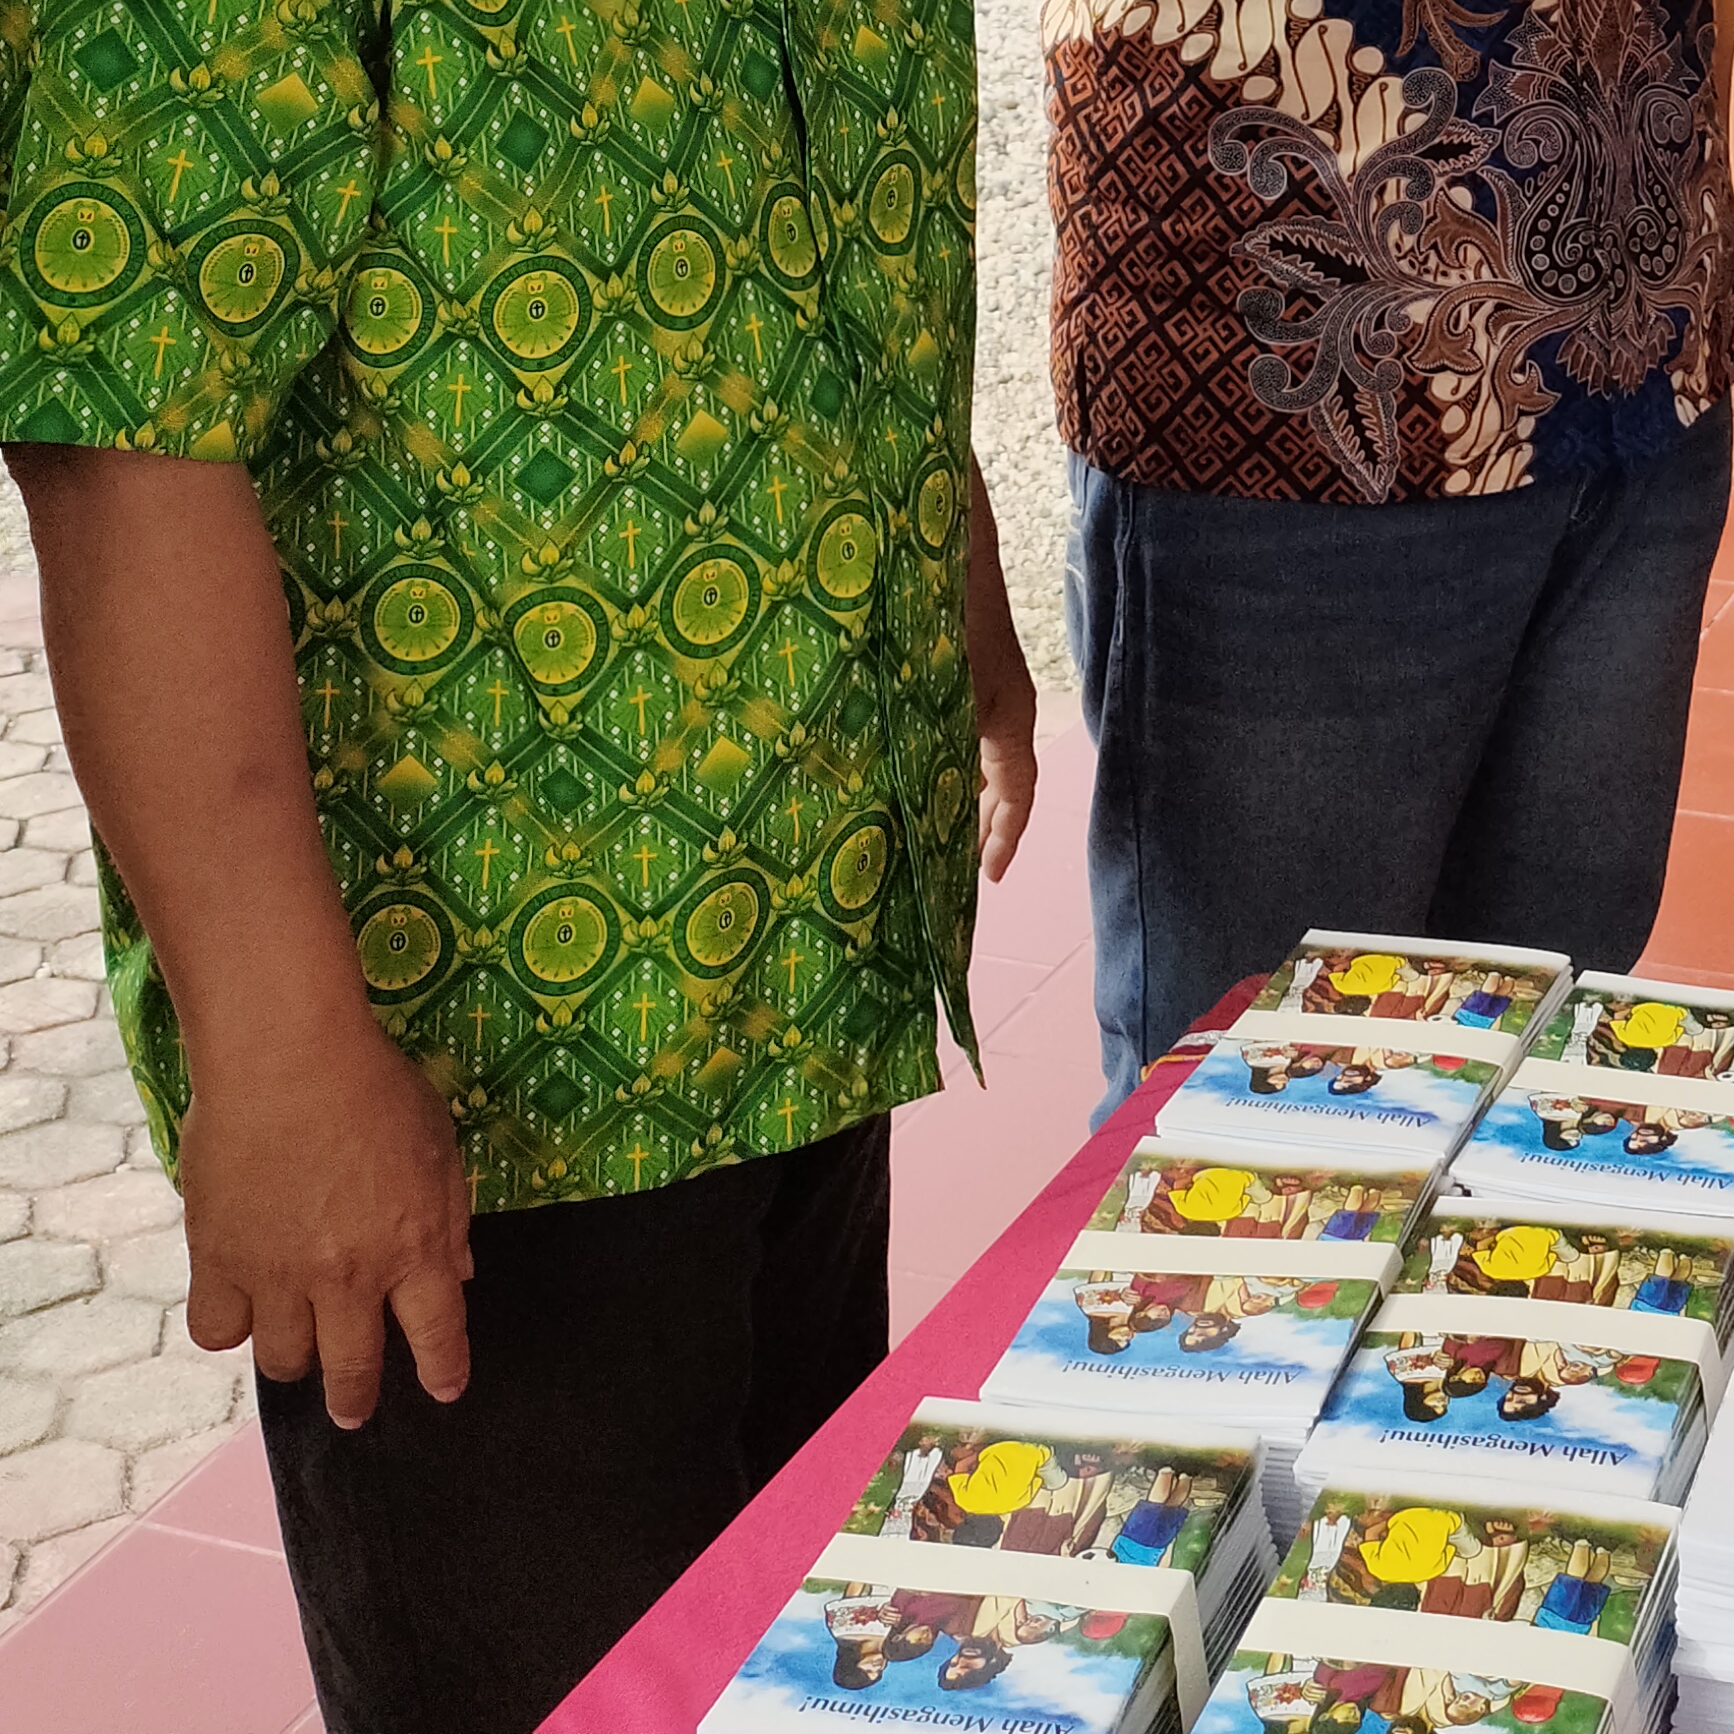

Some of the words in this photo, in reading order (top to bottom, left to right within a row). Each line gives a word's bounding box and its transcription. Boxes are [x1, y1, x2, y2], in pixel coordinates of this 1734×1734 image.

[1225, 1097, 1371, 1121] Mengasihimu!
[1377, 1112, 1432, 1129] Allah
[1520, 1152, 1671, 1182] Mengasihimu!
[1676, 1173, 1734, 1190] Allah
[1062, 1359, 1231, 1383] Mengasihimu!
[1238, 1367, 1302, 1385] Allah
[1378, 1428, 1555, 1458] Mengasihimu!
[1562, 1445, 1629, 1466] Allah
[798, 1695, 994, 1734] Mengasihimu!
